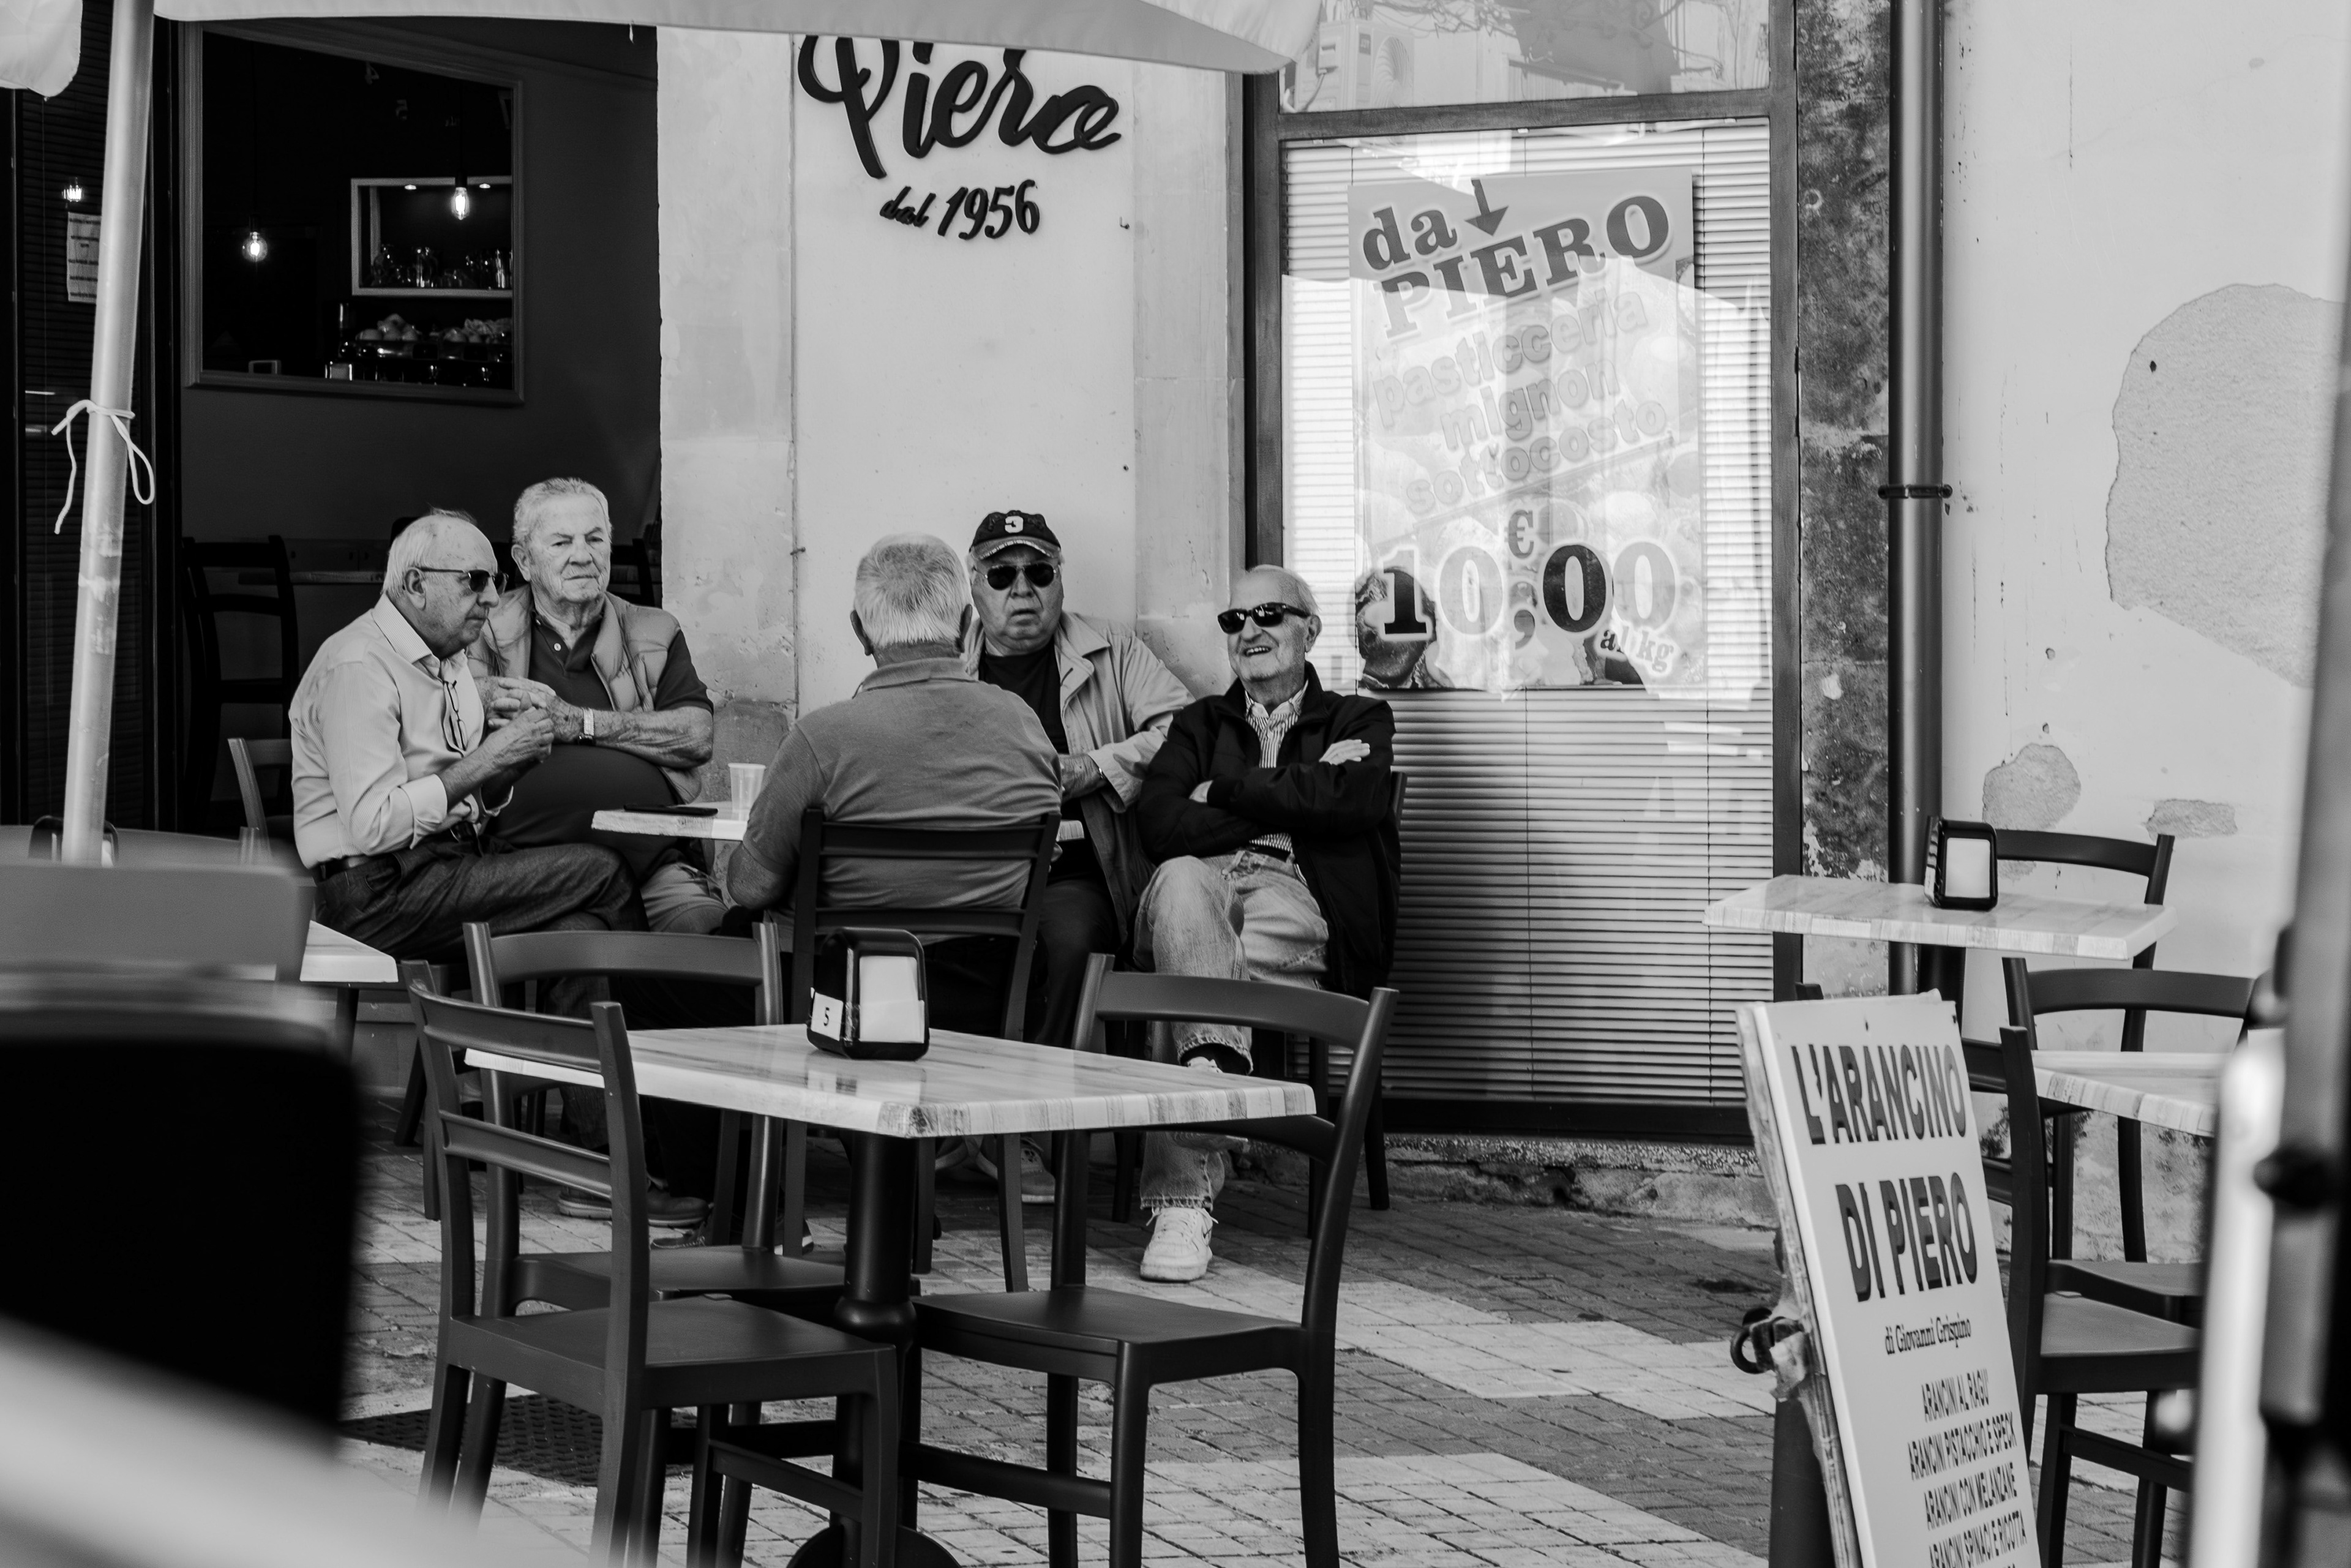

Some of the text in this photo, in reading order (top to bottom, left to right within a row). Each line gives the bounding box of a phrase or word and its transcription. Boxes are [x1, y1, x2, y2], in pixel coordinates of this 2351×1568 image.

[879, 179, 1041, 241] dal 1956
[1362, 206, 1457, 271] da
[1379, 195, 1670, 339] PIERO
[1373, 287, 1648, 427] pasticceria
[1440, 359, 1619, 441] mignon
[1406, 400, 1666, 514] sottocosto
[1504, 509, 1535, 559] €
[1382, 541, 1676, 650] 10,00
[1636, 629, 1674, 673] kg
[823, 1007, 830, 1026] 5
[1791, 1044, 1967, 1145] L'ARANCINO
[1835, 1172, 1978, 1302] DI PIERO
[1885, 1326, 1895, 1356] di
[1895, 1317, 1936, 1352] Giovanni
[1921, 1376, 1959, 1423] ARANCINI
[1957, 1375, 1970, 1412] AL
[1907, 1433, 1946, 1480] ARANCINI
[1986, 1418, 1994, 1455] E
[1992, 1411, 2018, 1453] SPECK
[1924, 1461, 2017, 1531] ARANCINI CON MELANZANE
[1991, 1520, 2000, 1556] E
[1997, 1509, 2028, 1555] RICOTTA
